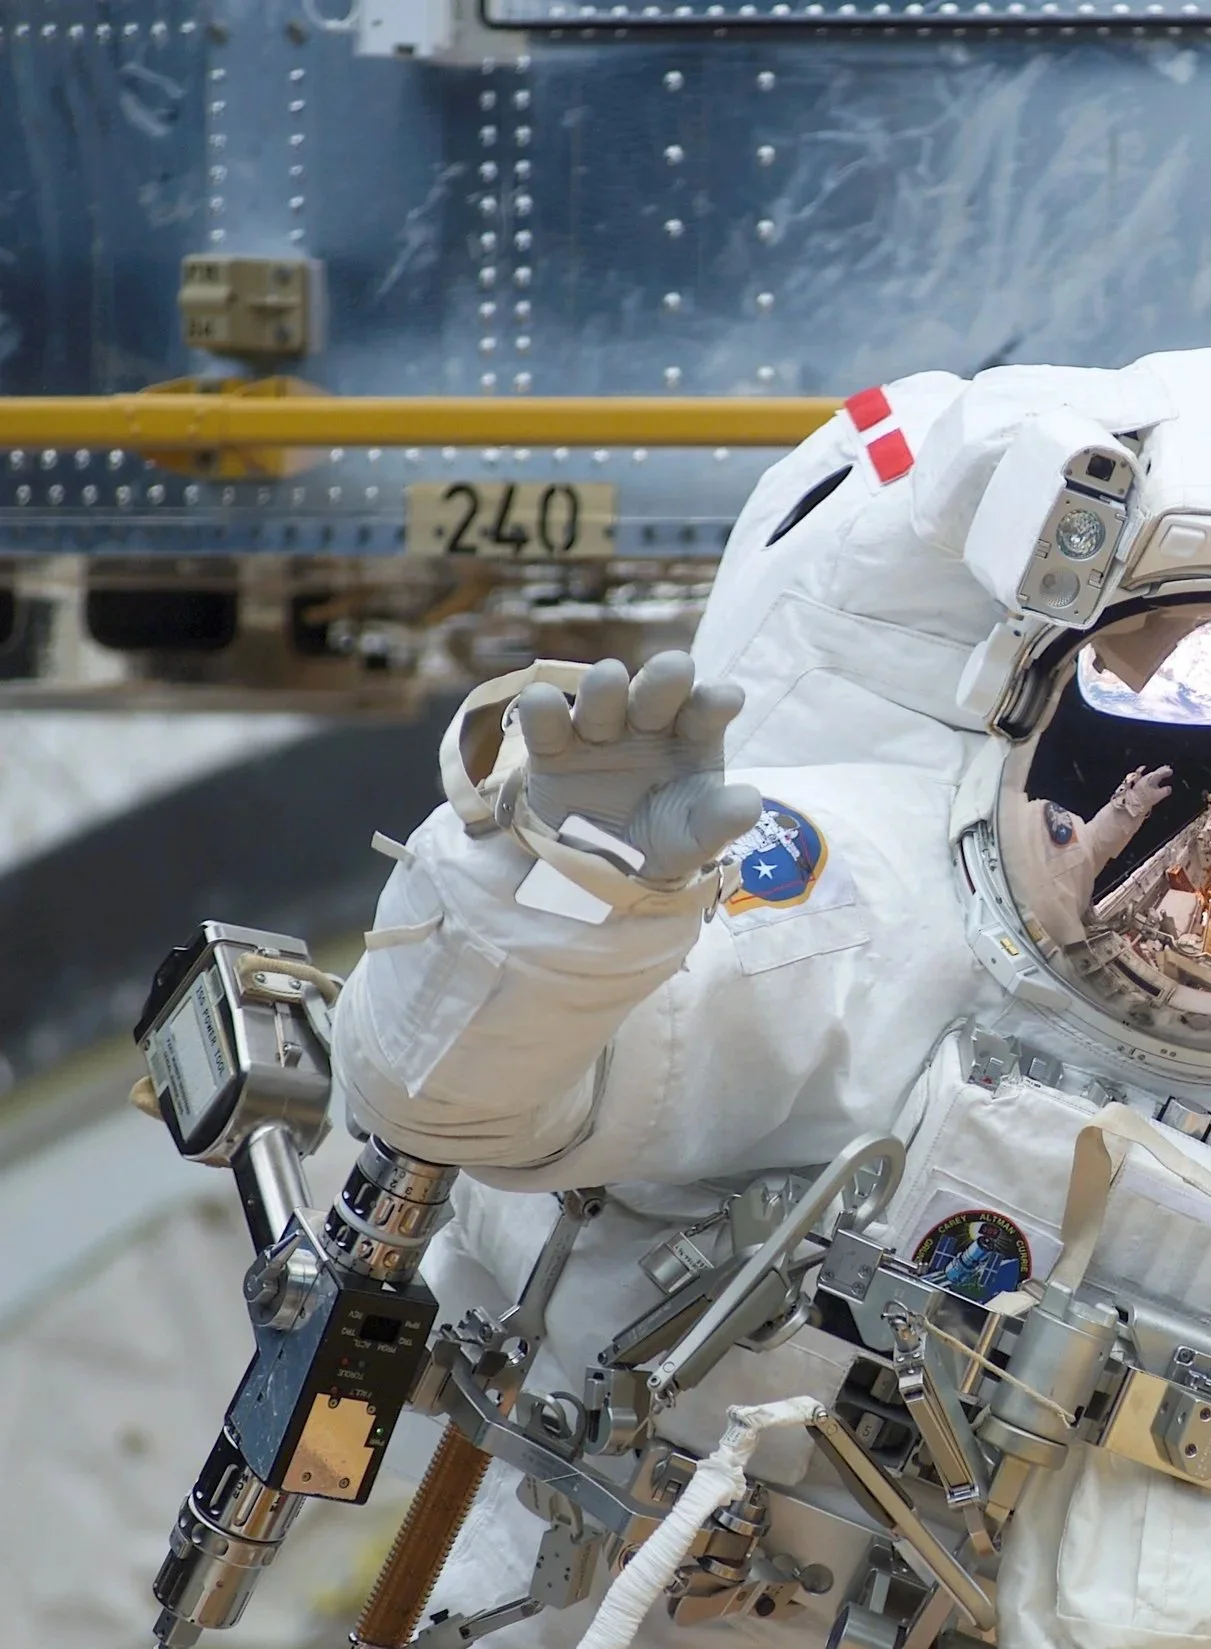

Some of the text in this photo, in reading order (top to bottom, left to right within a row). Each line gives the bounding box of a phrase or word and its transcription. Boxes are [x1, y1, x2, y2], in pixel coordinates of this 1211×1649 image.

[442, 481, 579, 554] 240
[202, 1008, 217, 1046] POWER
[213, 1046, 225, 1077] TOOL
[938, 1215, 967, 1234] CAREY
[979, 1213, 1016, 1236] ALTMAN
[1015, 1240, 1030, 1274] CURRIE
[337, 1368, 365, 1380] TORQUE
